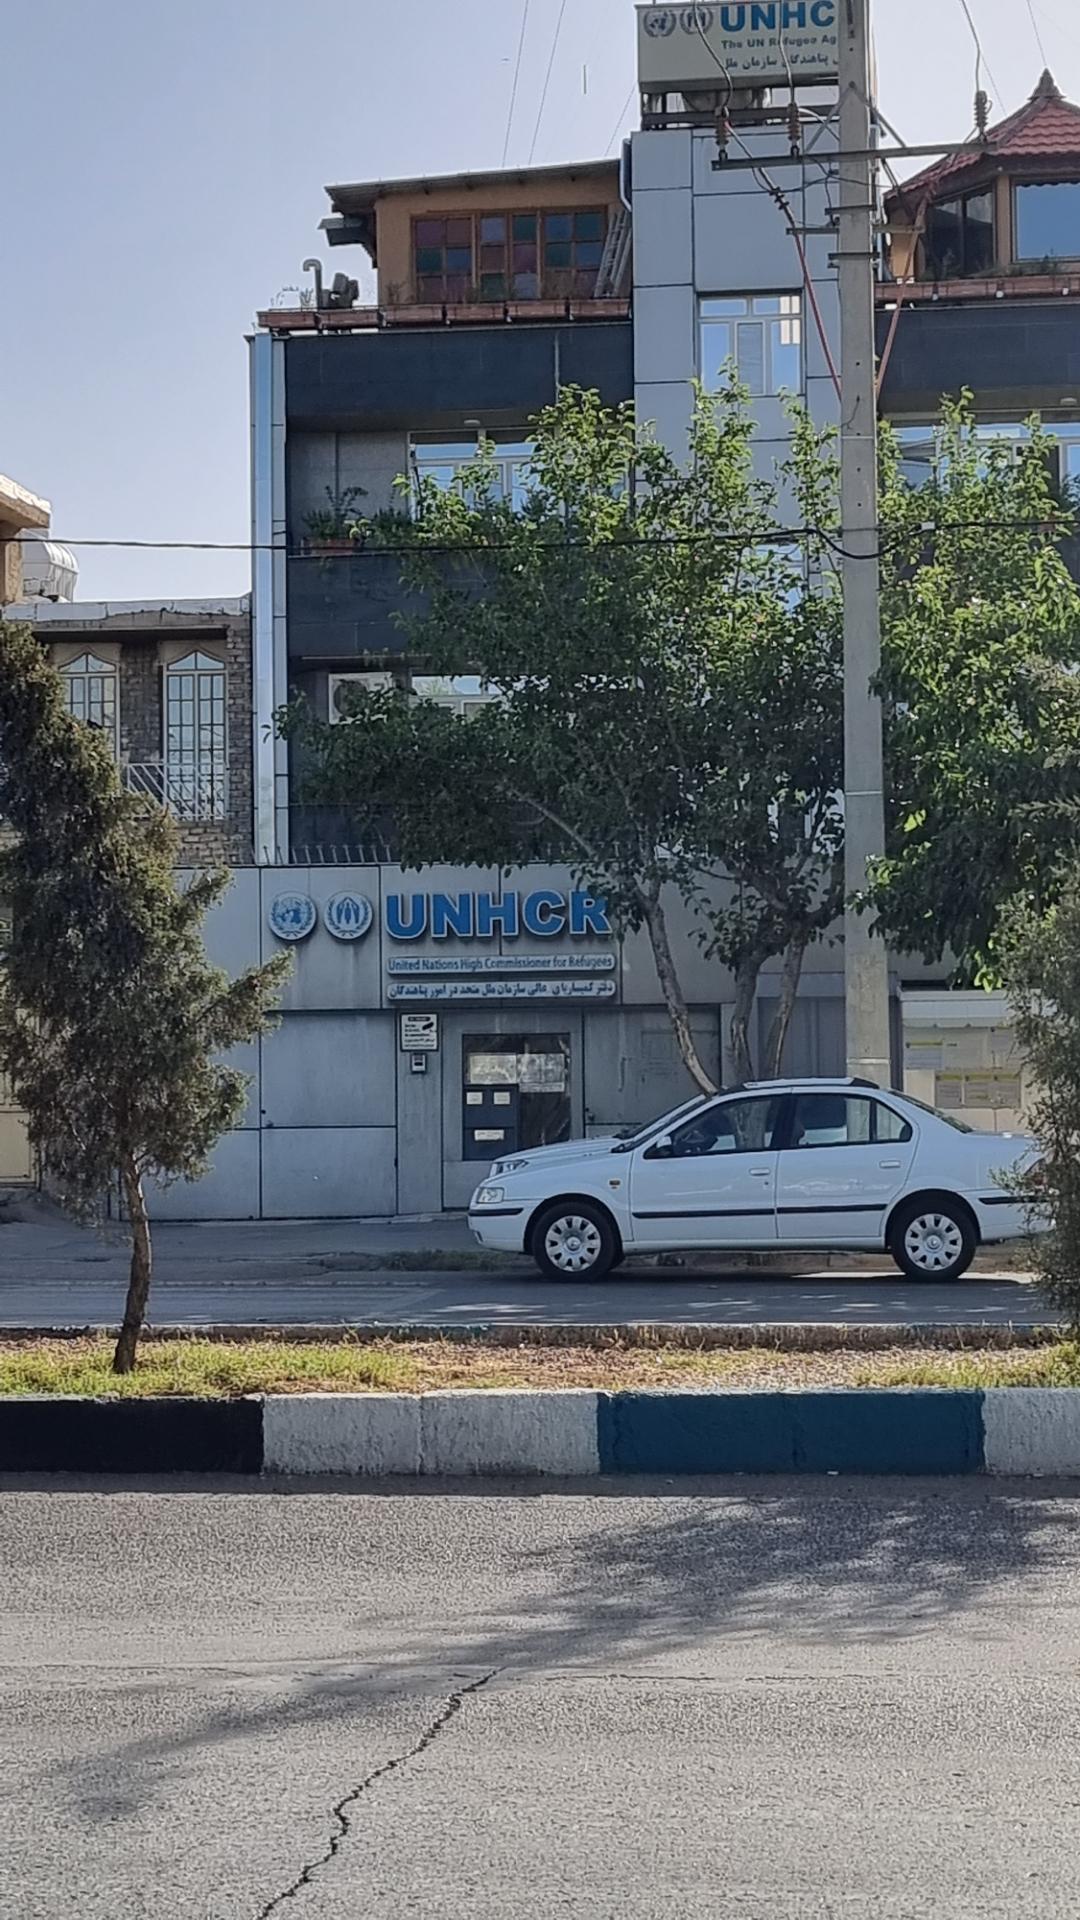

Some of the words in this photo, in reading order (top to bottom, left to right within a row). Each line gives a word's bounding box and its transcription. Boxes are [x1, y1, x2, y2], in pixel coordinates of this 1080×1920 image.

[720, 0, 835, 32] UNHC
[721, 40, 743, 49] The
[747, 38, 765, 47] UN
[742, 55, 778, 70] سازمان
[386, 890, 612, 939] UNHCR
[389, 960, 420, 970] United
[422, 960, 459, 970] Nations
[461, 959, 483, 972] High
[484, 957, 550, 970] Commissioner
[553, 956, 567, 967] for
[568, 955, 612, 970] Refugees
[389, 985, 428, 998] پناهندگان
[430, 985, 446, 998] امور
[449, 986, 458, 997] در
[460, 985, 480, 994] متحد
[482, 984, 496, 996] ملل
[497, 984, 525, 997] سازمان
[527, 983, 548, 996] عالی
